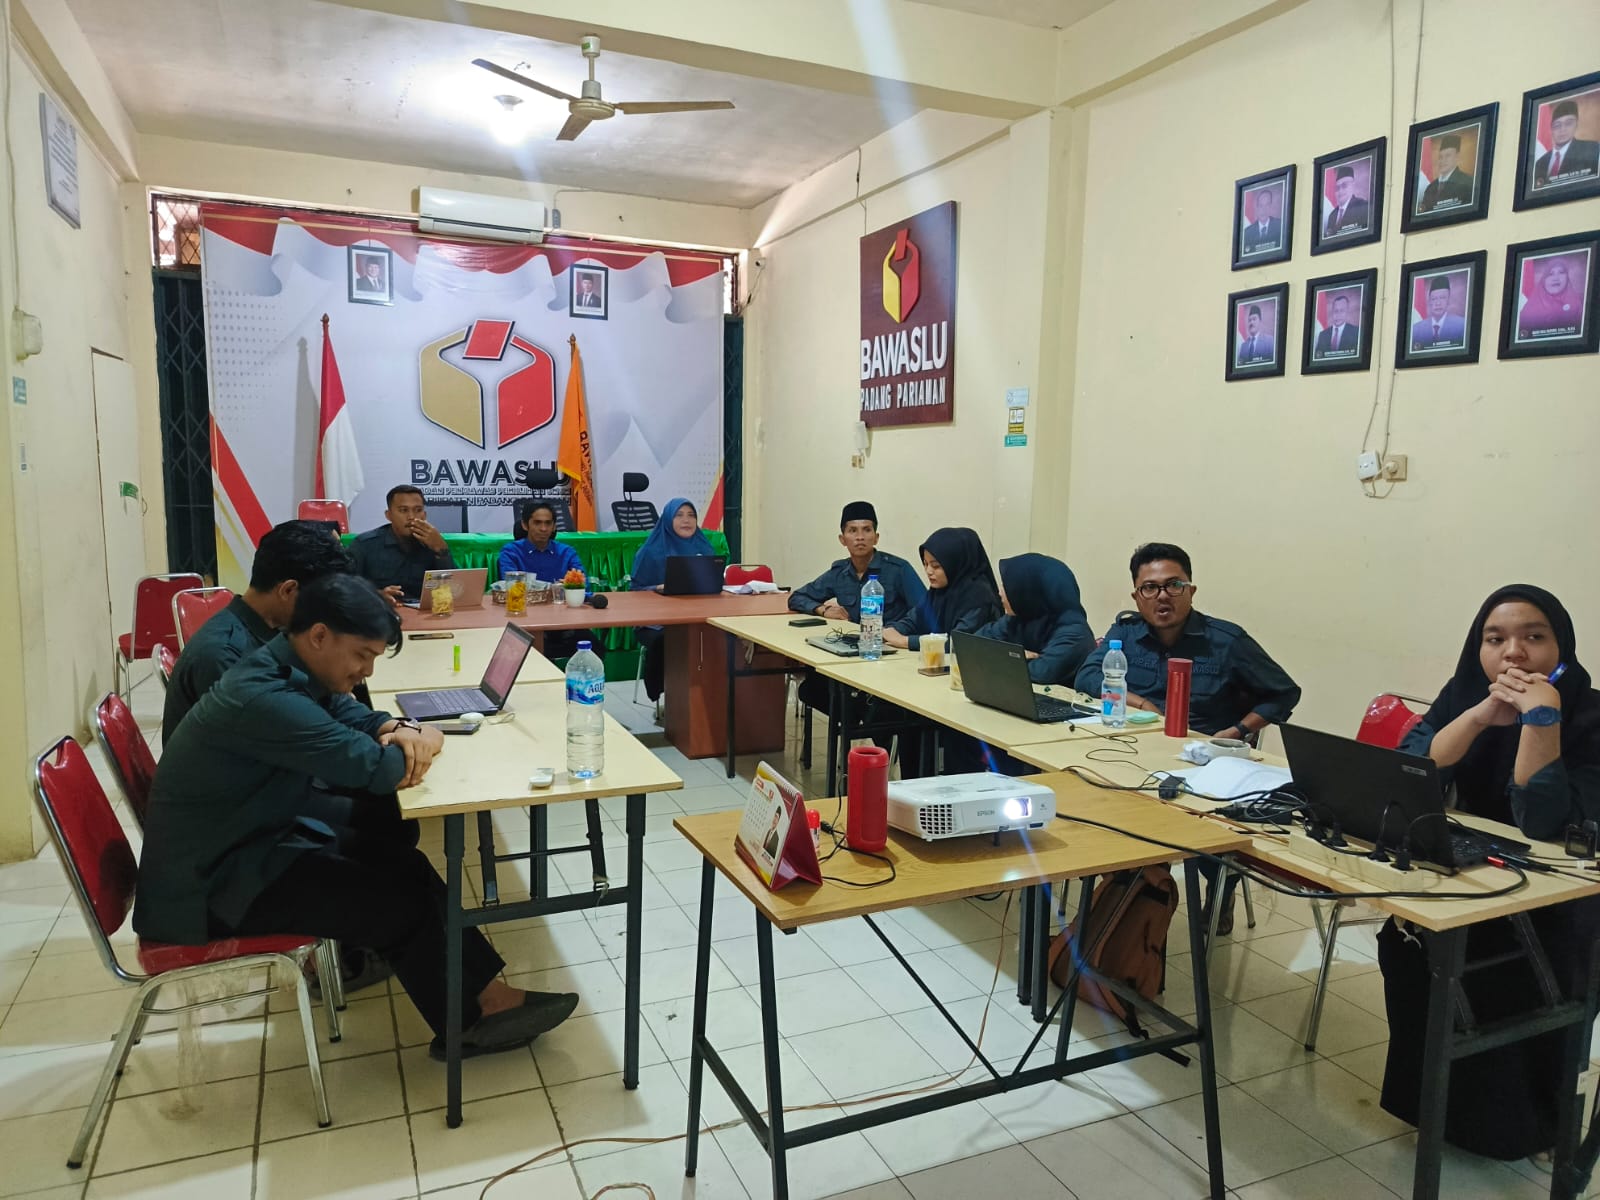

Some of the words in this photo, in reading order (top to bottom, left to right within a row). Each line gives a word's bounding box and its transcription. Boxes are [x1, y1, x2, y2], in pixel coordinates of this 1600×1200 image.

[860, 321, 948, 381] BAWASLU
[860, 384, 892, 411] PADANG
[896, 377, 946, 409] PARIAMAN
[588, 683, 605, 694] AQU
